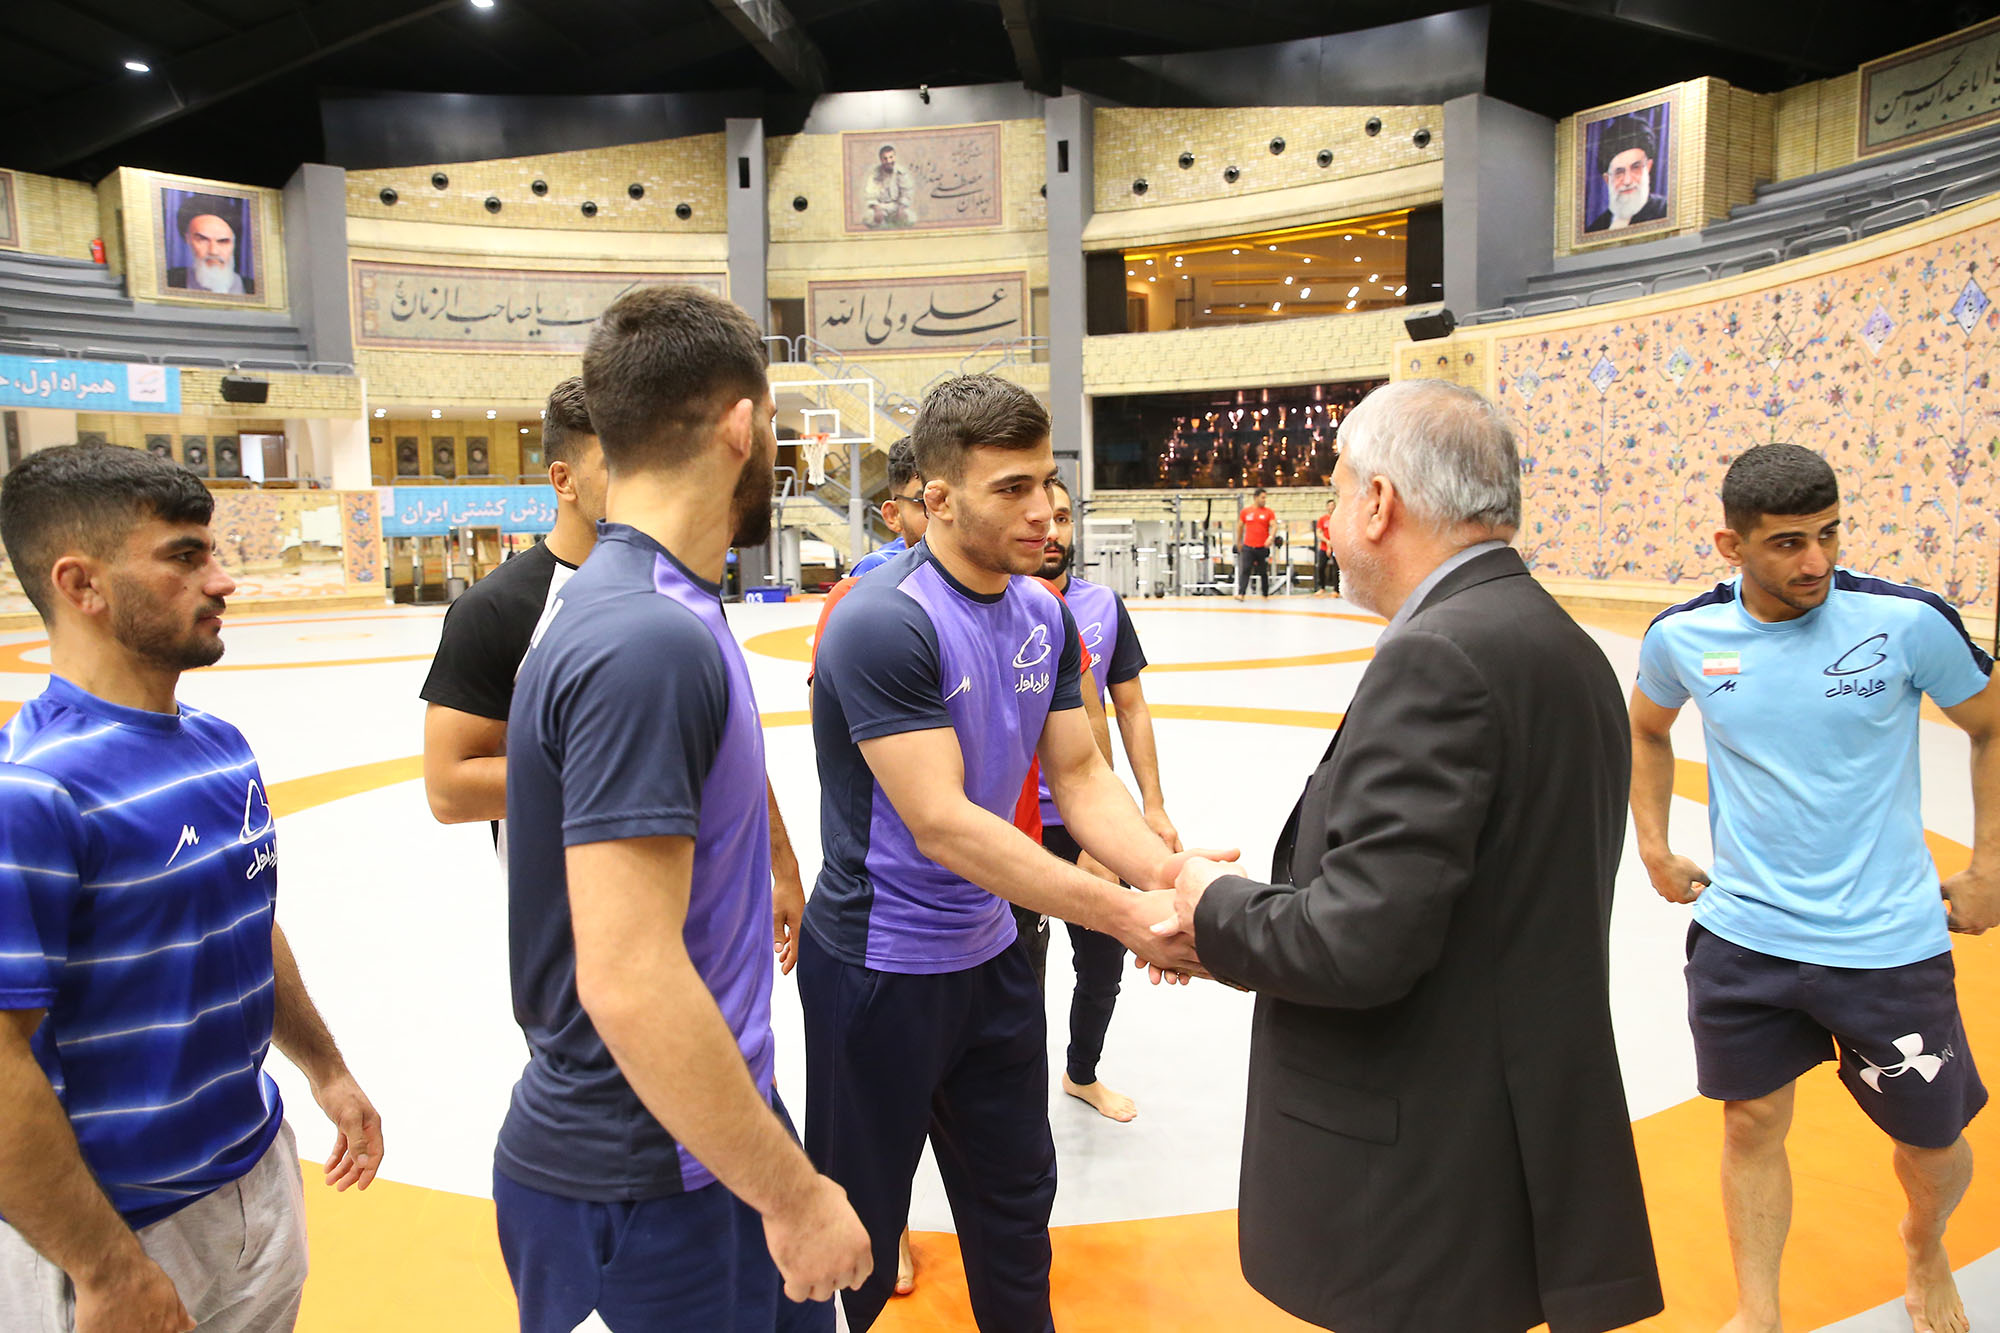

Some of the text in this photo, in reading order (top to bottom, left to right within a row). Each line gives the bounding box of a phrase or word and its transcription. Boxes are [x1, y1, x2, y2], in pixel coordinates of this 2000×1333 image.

[391, 287, 459, 322] الزمان
[446, 296, 532, 334] صاحب
[865, 292, 908, 345] ولی
[911, 287, 1018, 337] علی
[61, 372, 116, 400] همراه
[401, 498, 557, 525] رزش کشتی ایران
